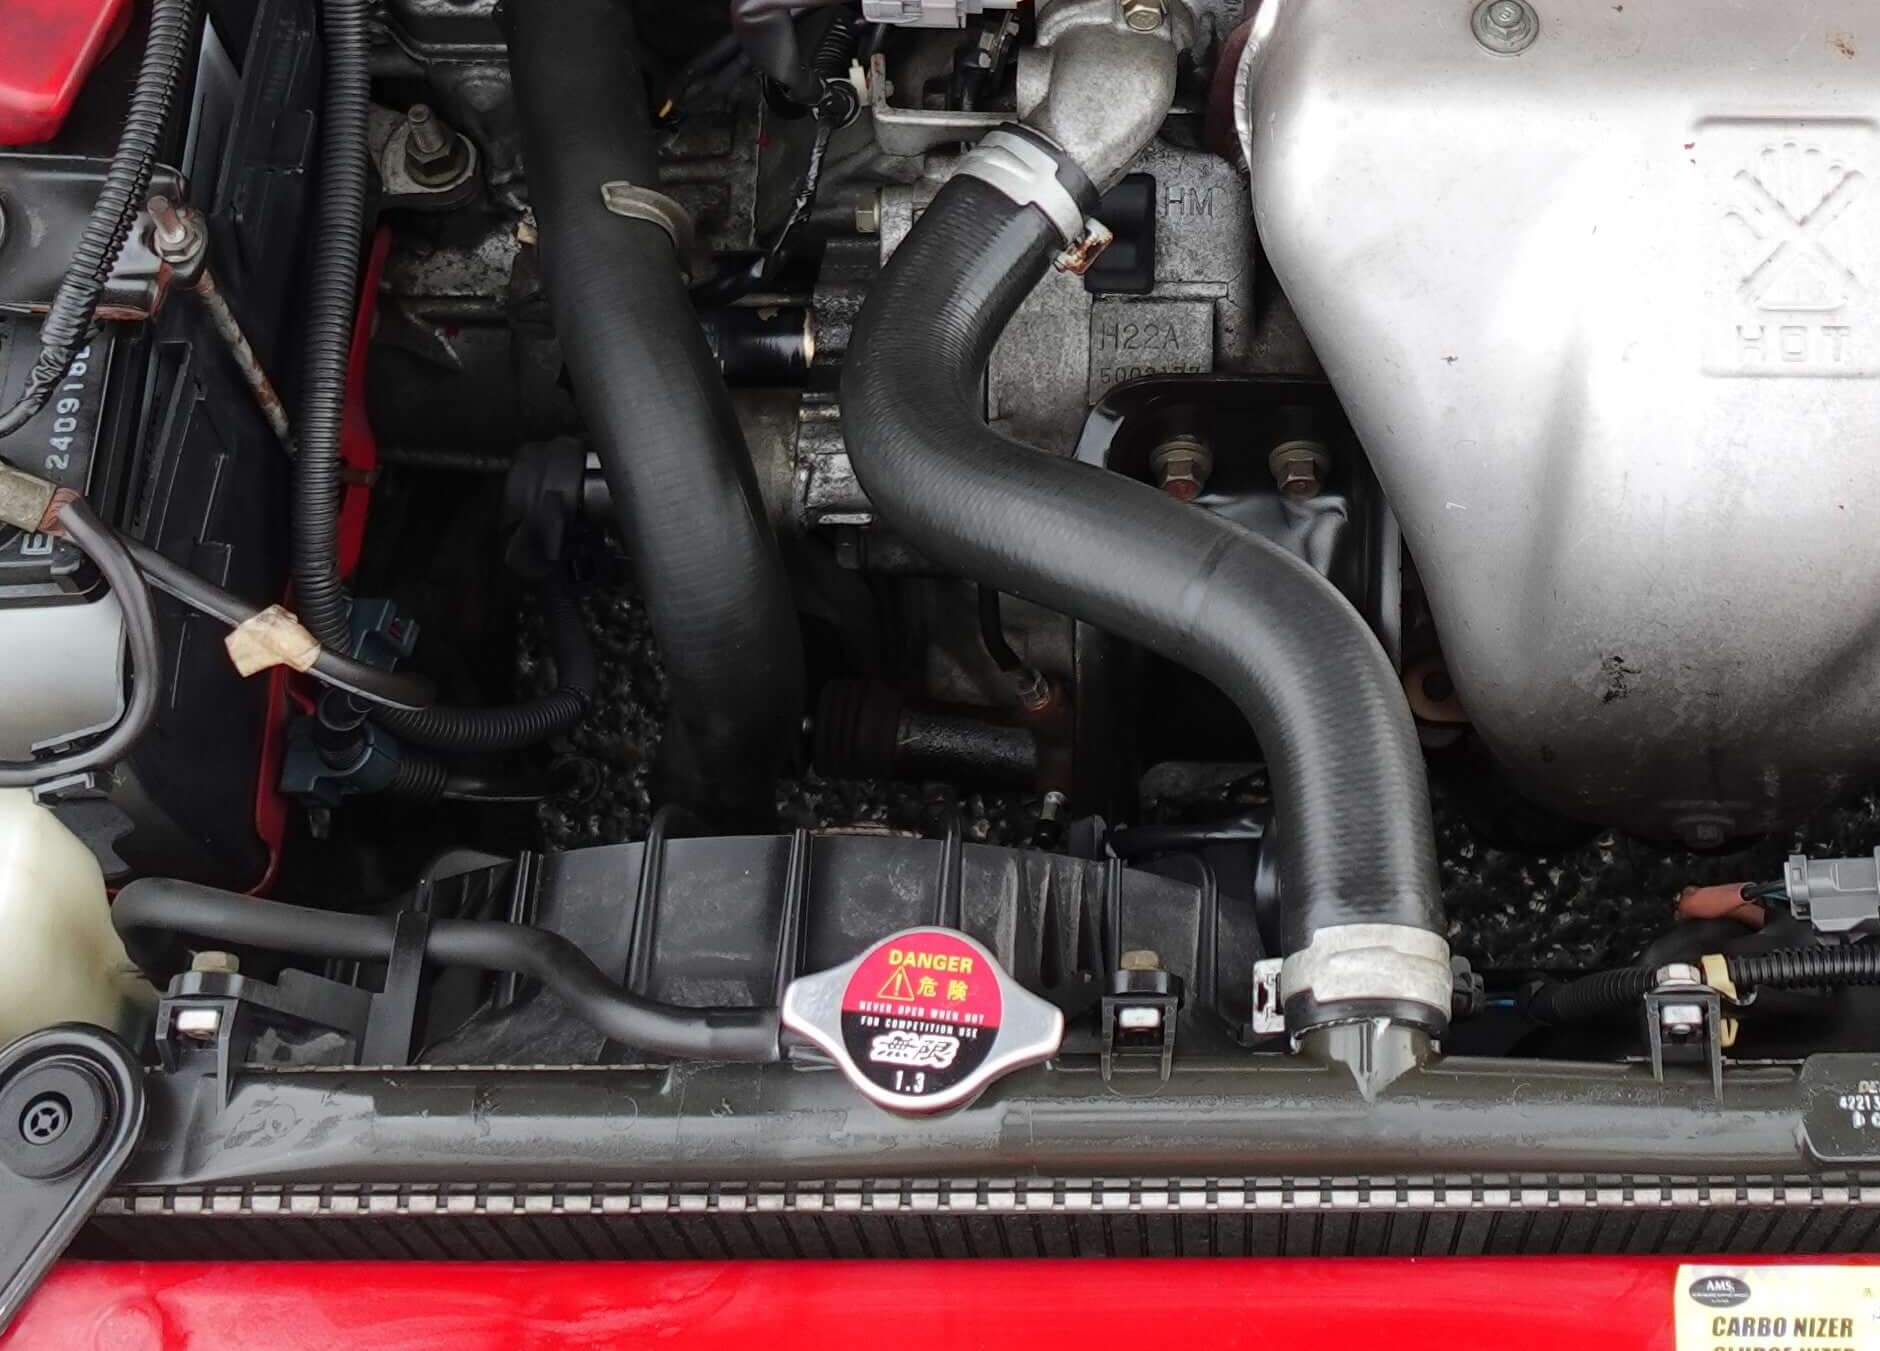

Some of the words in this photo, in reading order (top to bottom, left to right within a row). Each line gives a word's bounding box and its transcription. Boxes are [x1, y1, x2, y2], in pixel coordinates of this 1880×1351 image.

[1100, 323, 1180, 351] H22A
[1736, 324, 1851, 363] HOT
[889, 949, 974, 975] DANGER
[917, 975, 968, 1001] 危険
[859, 1001, 892, 1013] NEVER
[898, 1005, 924, 1017] OPEN
[930, 1008, 959, 1021] WHEN
[860, 1015, 880, 1027] FOR
[885, 1018, 954, 1035] COMPETITION
[958, 1028, 979, 1039] USE
[895, 1069, 926, 1094] 1.3
[1712, 1317, 1788, 1338] CARBO
[1793, 1317, 1854, 1338] NIZER
